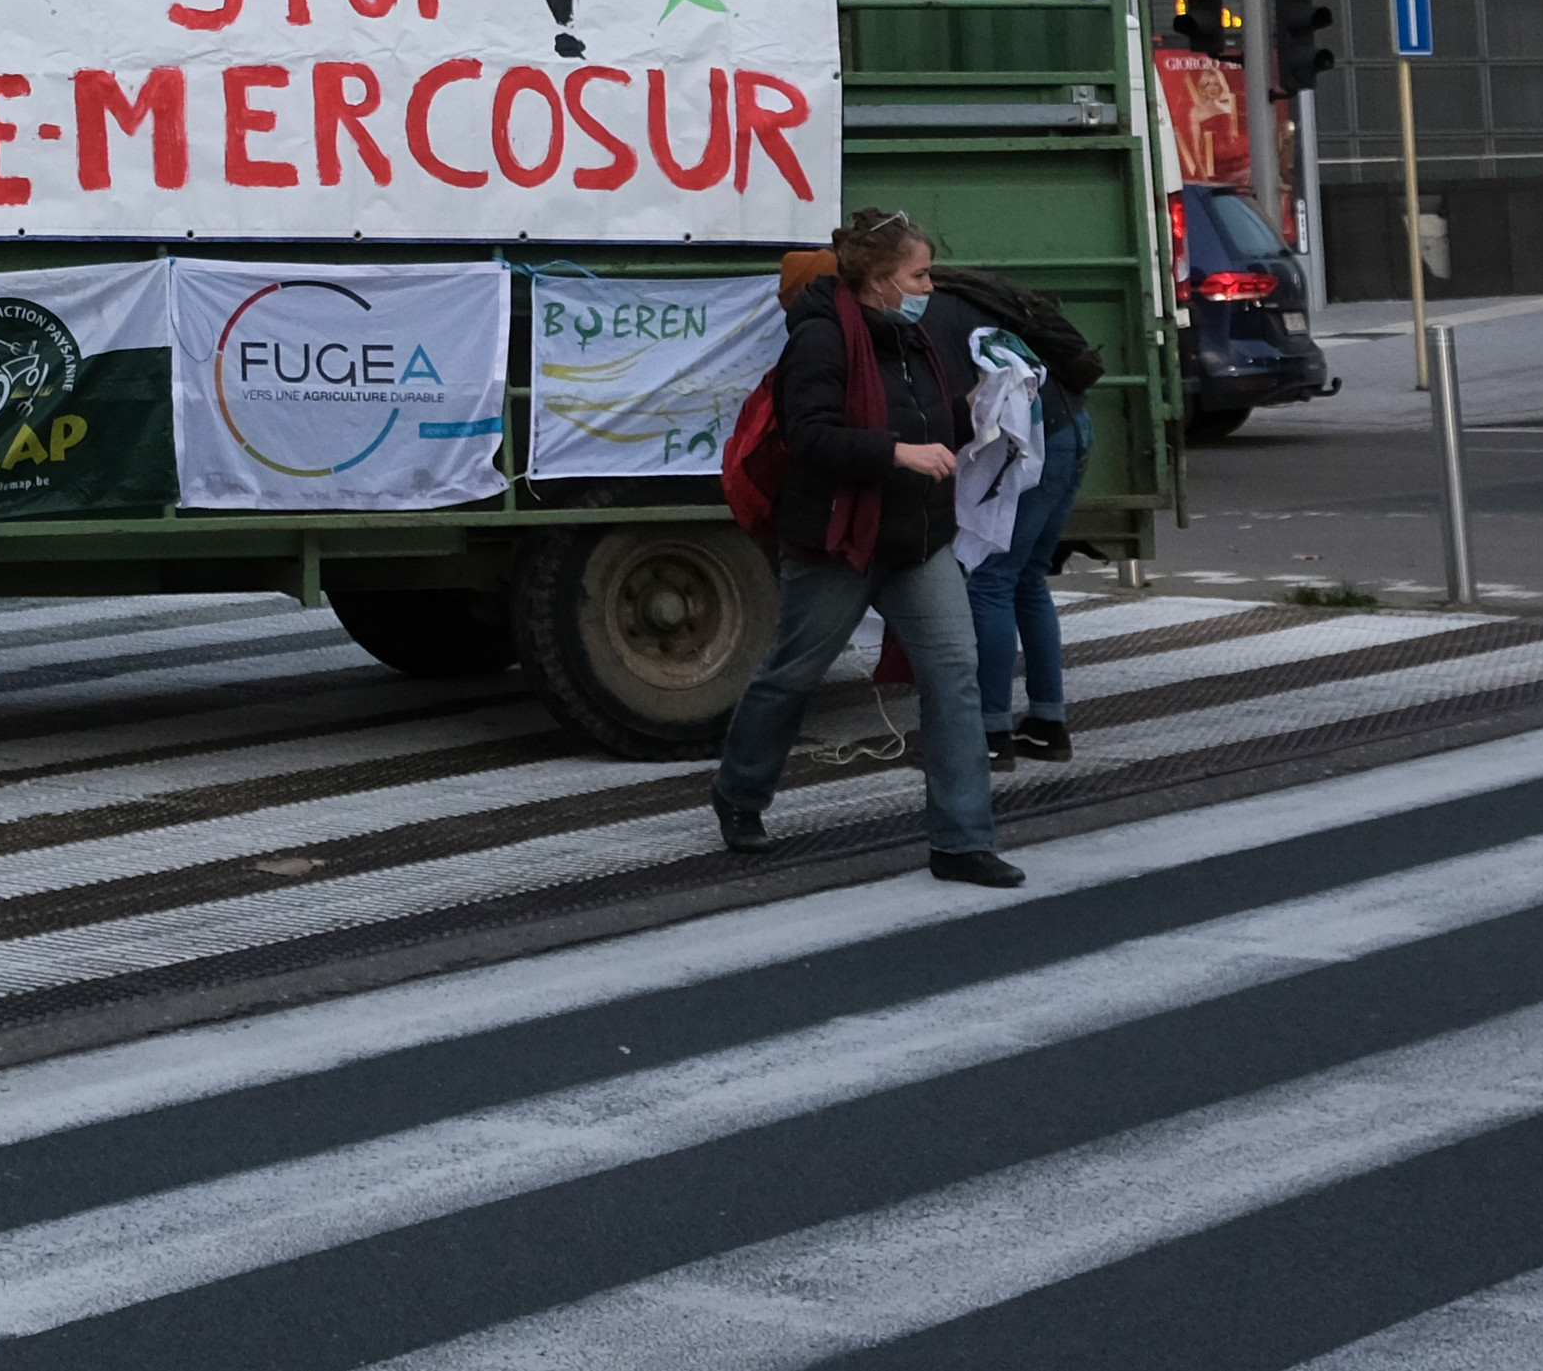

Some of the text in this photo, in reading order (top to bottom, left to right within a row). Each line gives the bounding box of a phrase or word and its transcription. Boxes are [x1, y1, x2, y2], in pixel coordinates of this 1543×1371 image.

[241, 341, 444, 387] FUGEA
[242, 390, 273, 401] VERS
[276, 390, 300, 401] UNE
[391, 392, 445, 403] DURABLE
